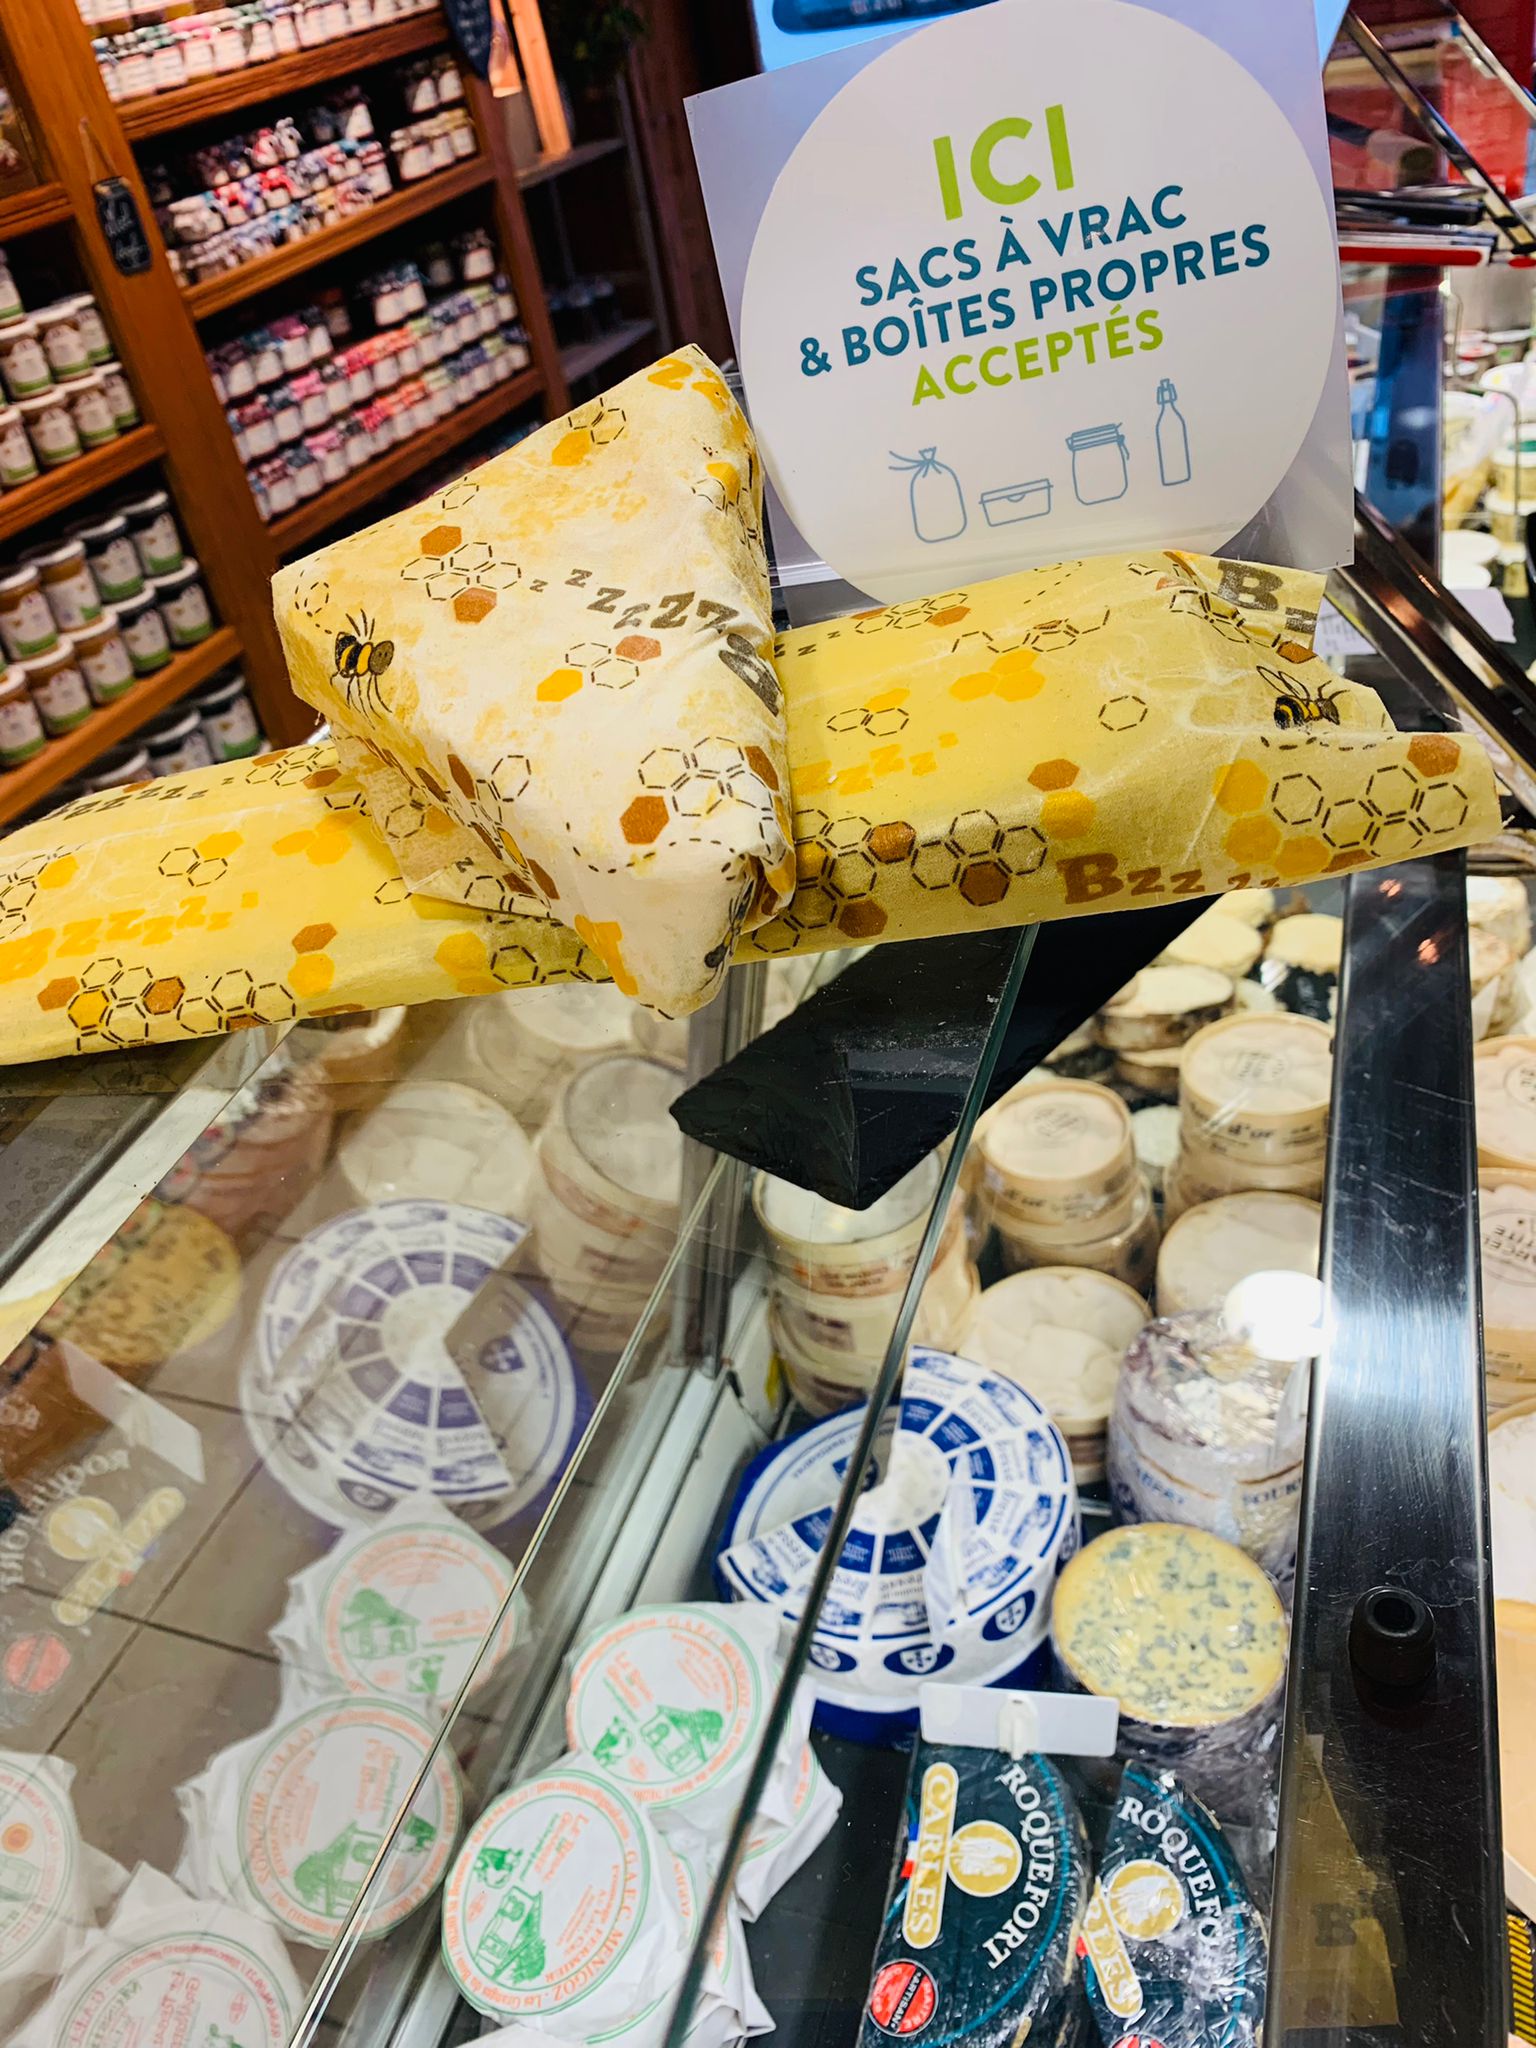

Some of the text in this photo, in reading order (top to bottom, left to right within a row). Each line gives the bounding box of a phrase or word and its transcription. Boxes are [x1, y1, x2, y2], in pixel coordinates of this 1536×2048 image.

[932, 104, 1074, 221] ICI
[800, 224, 1270, 377] & BOÎTES PROPRES
[856, 185, 1187, 306] SACS À VRAC
[912, 306, 1164, 406] ACCEPTÉS
[982, 1763, 1055, 1970] ROQUEFORT
